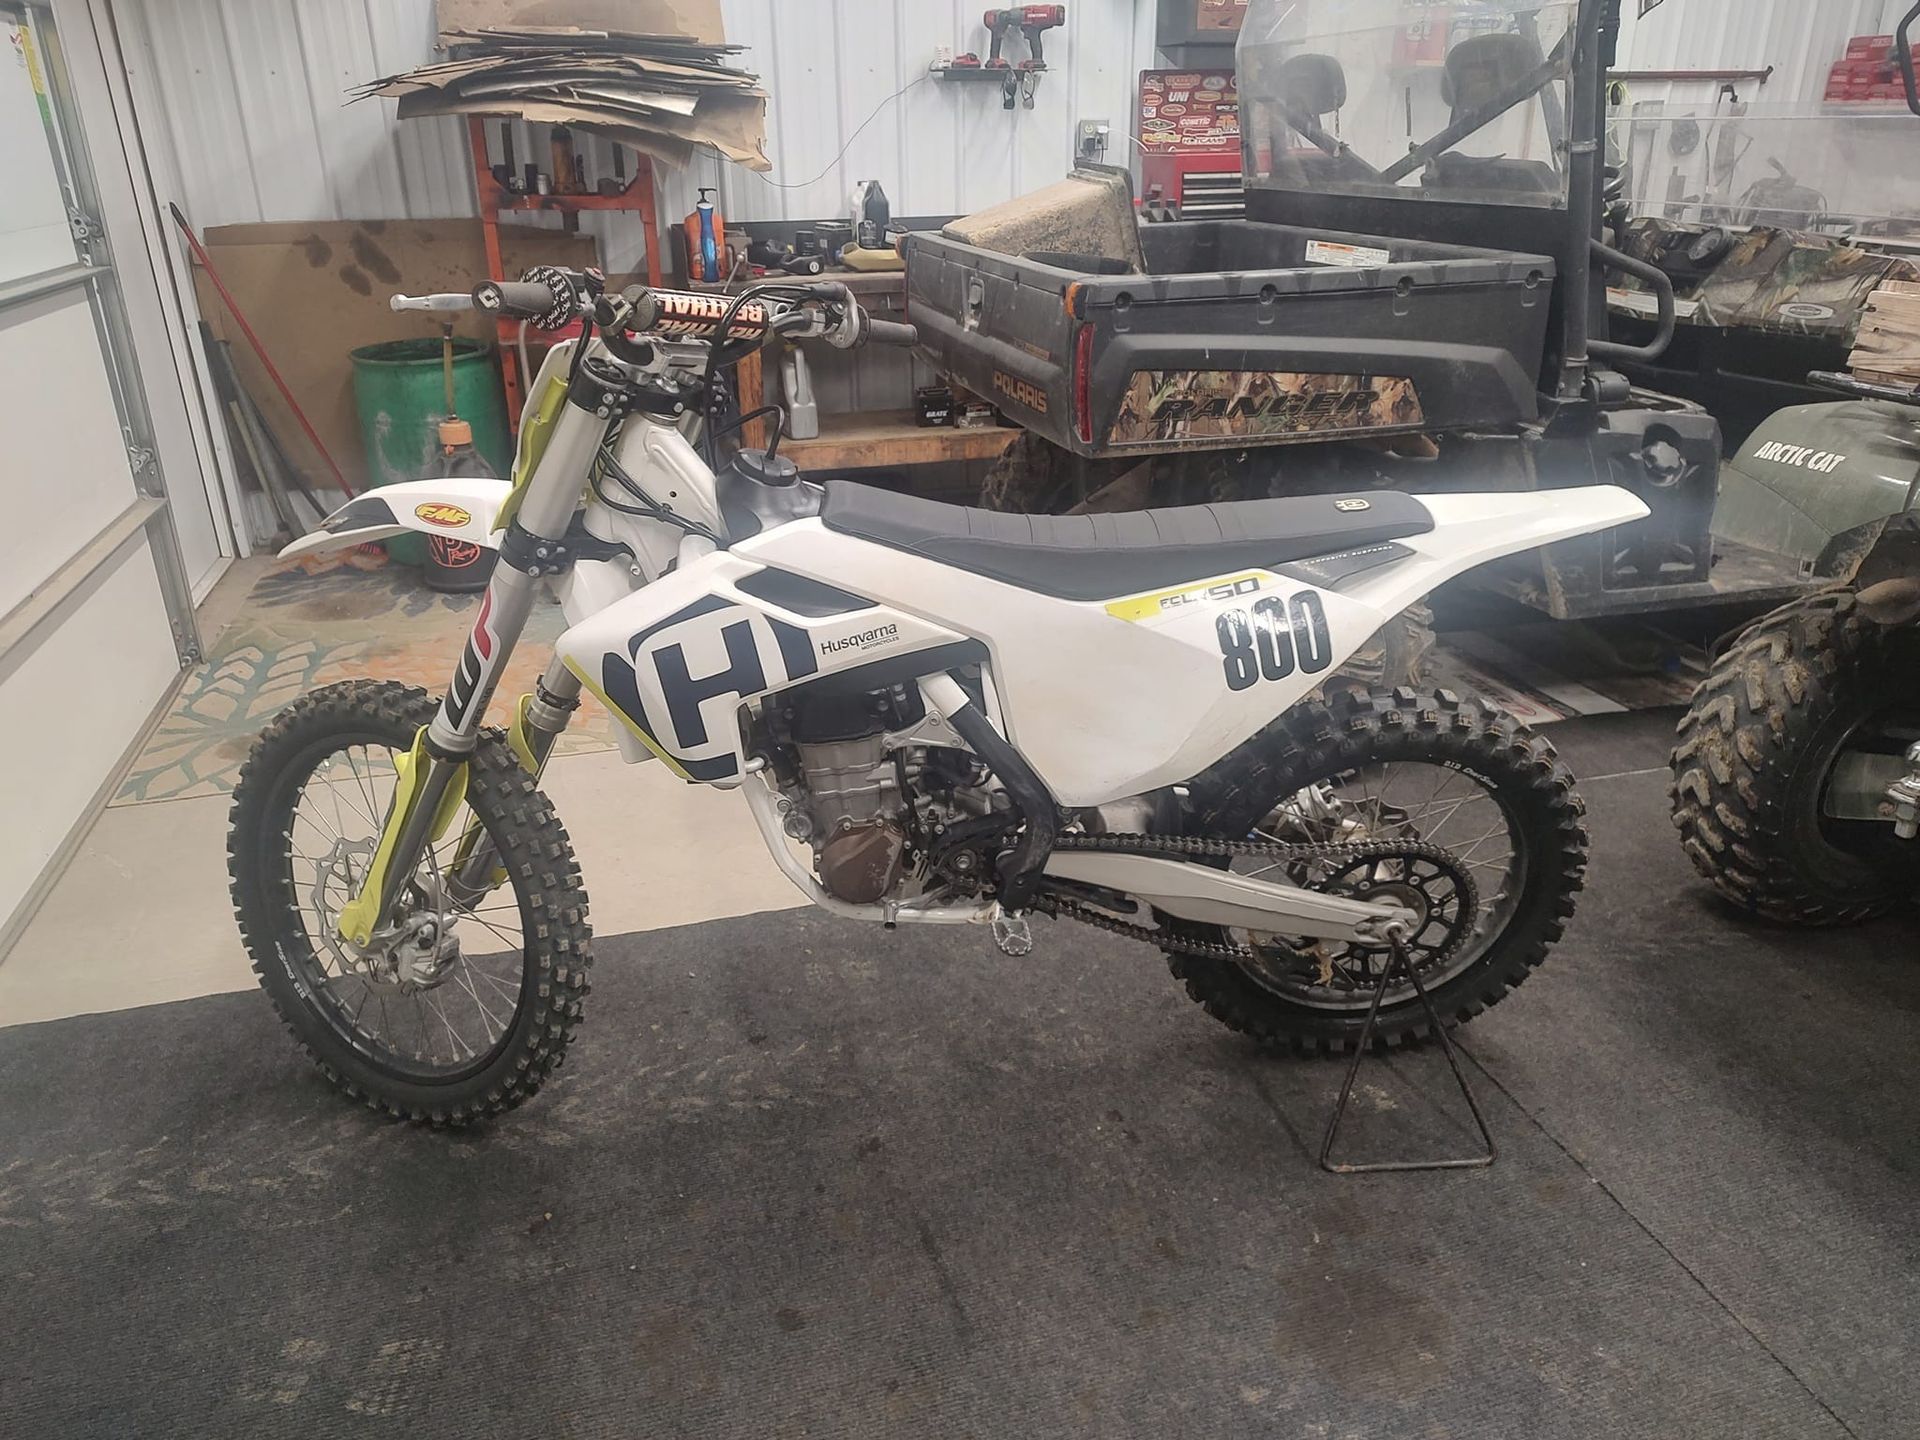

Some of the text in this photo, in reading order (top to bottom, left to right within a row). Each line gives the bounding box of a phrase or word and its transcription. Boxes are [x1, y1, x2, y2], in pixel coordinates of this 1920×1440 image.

[1168, 91, 1189, 102] UNI
[993, 371, 1047, 413] POLARIS
[1753, 441, 1846, 473] ARCTIC CAT
[417, 506, 470, 522] FMF
[821, 623, 898, 655] Husqvarna
[861, 636, 899, 650] MOTORCYCLES
[1215, 589, 1333, 691] 800
